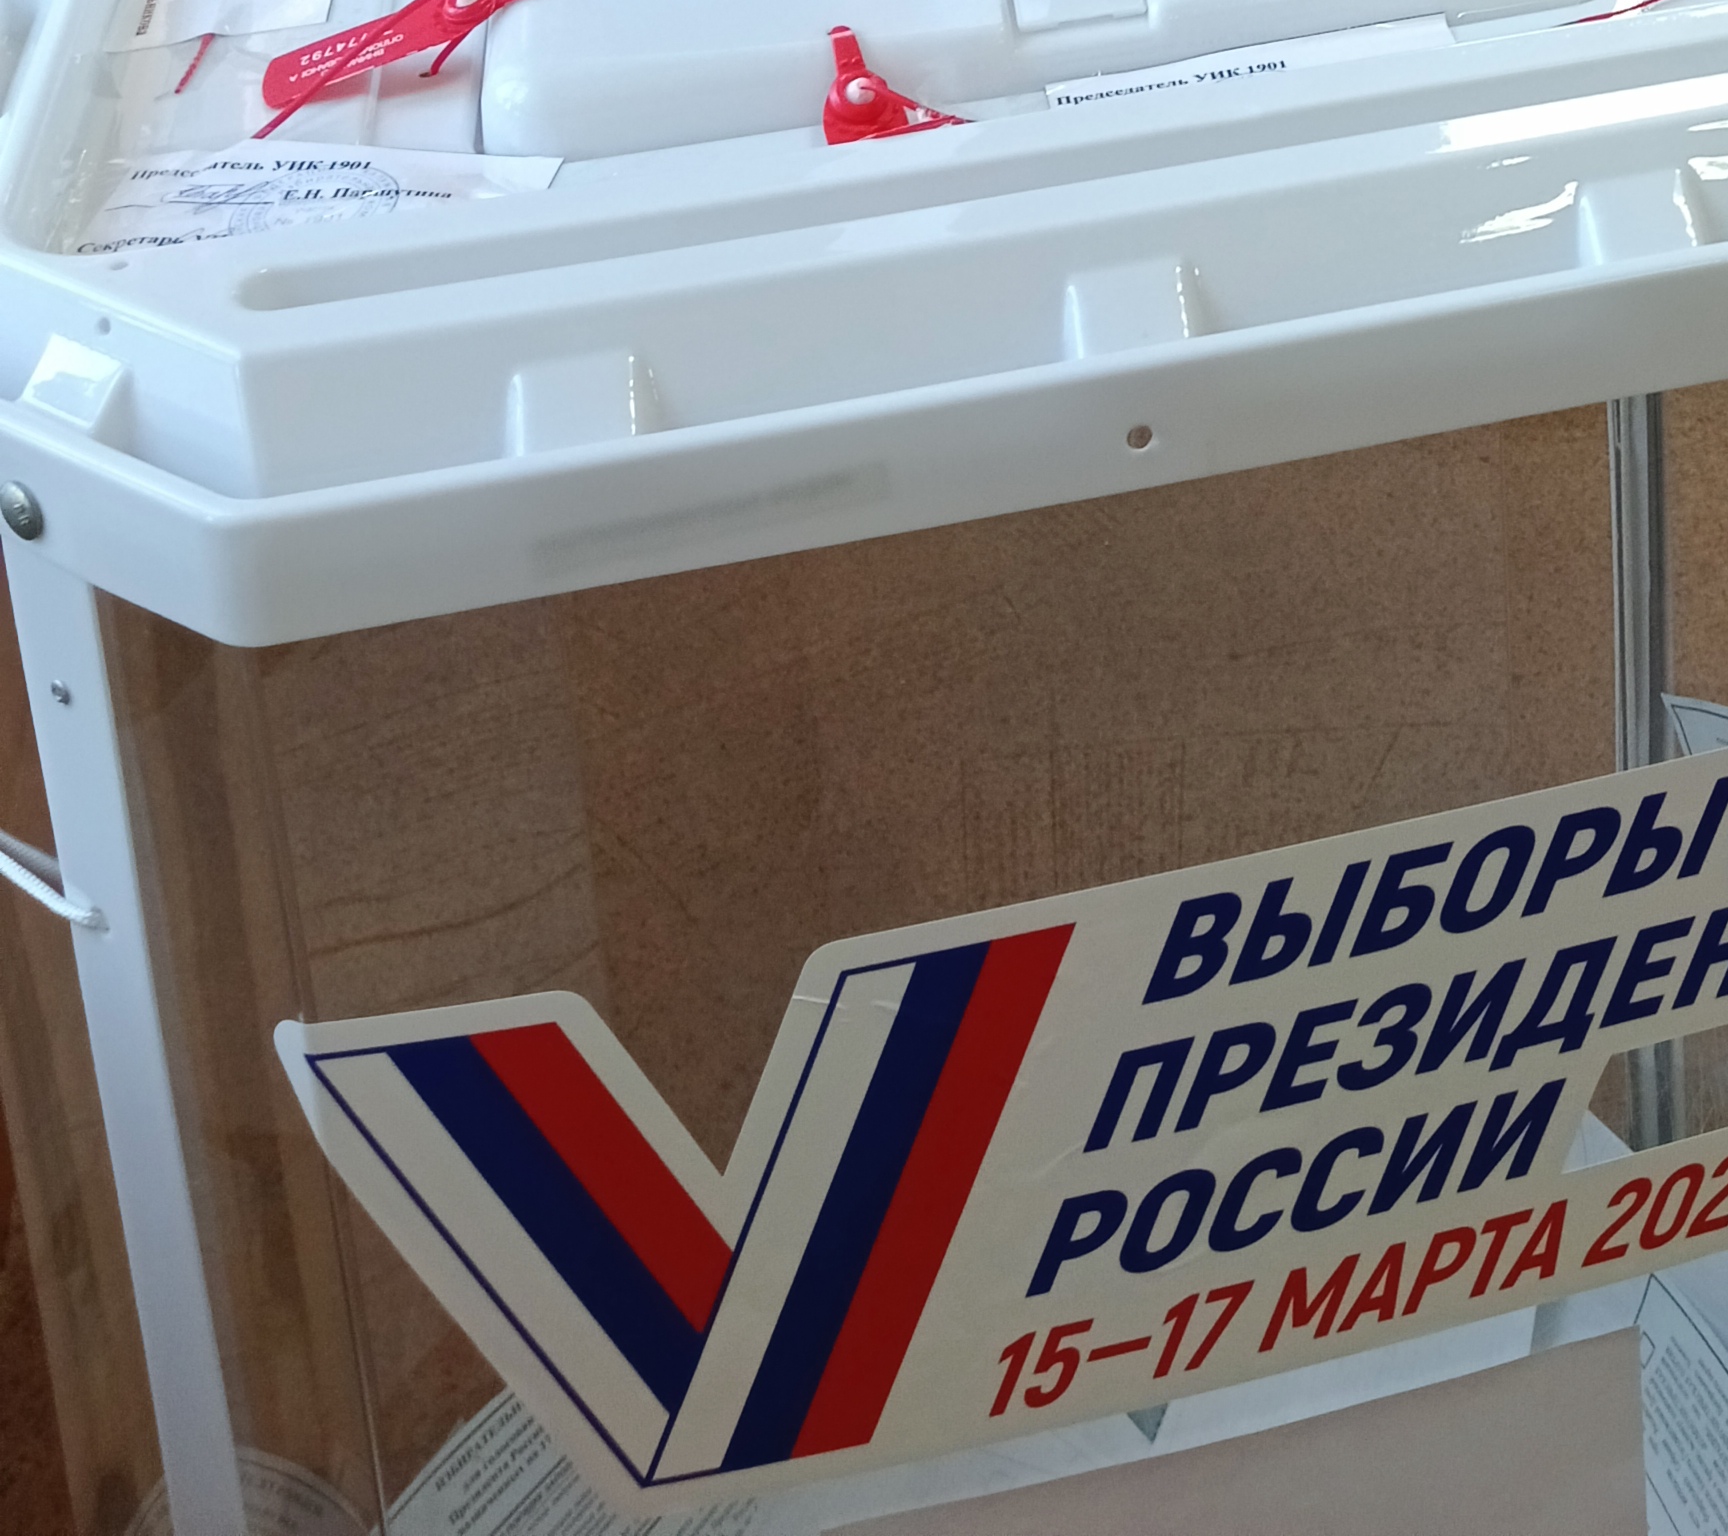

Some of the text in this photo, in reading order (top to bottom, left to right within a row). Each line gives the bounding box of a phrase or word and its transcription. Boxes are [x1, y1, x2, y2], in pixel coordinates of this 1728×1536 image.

[300, 28, 394, 66] 74792
[1056, 78, 1189, 106] Председатель
[130, 160, 264, 183] Предсеатель
[1026, 1079, 1566, 1298] РОССИИ
[1259, 1201, 1568, 1352] МАРТА
[434, 1399, 525, 1493] ИЗБИРАТЕЛЬН
